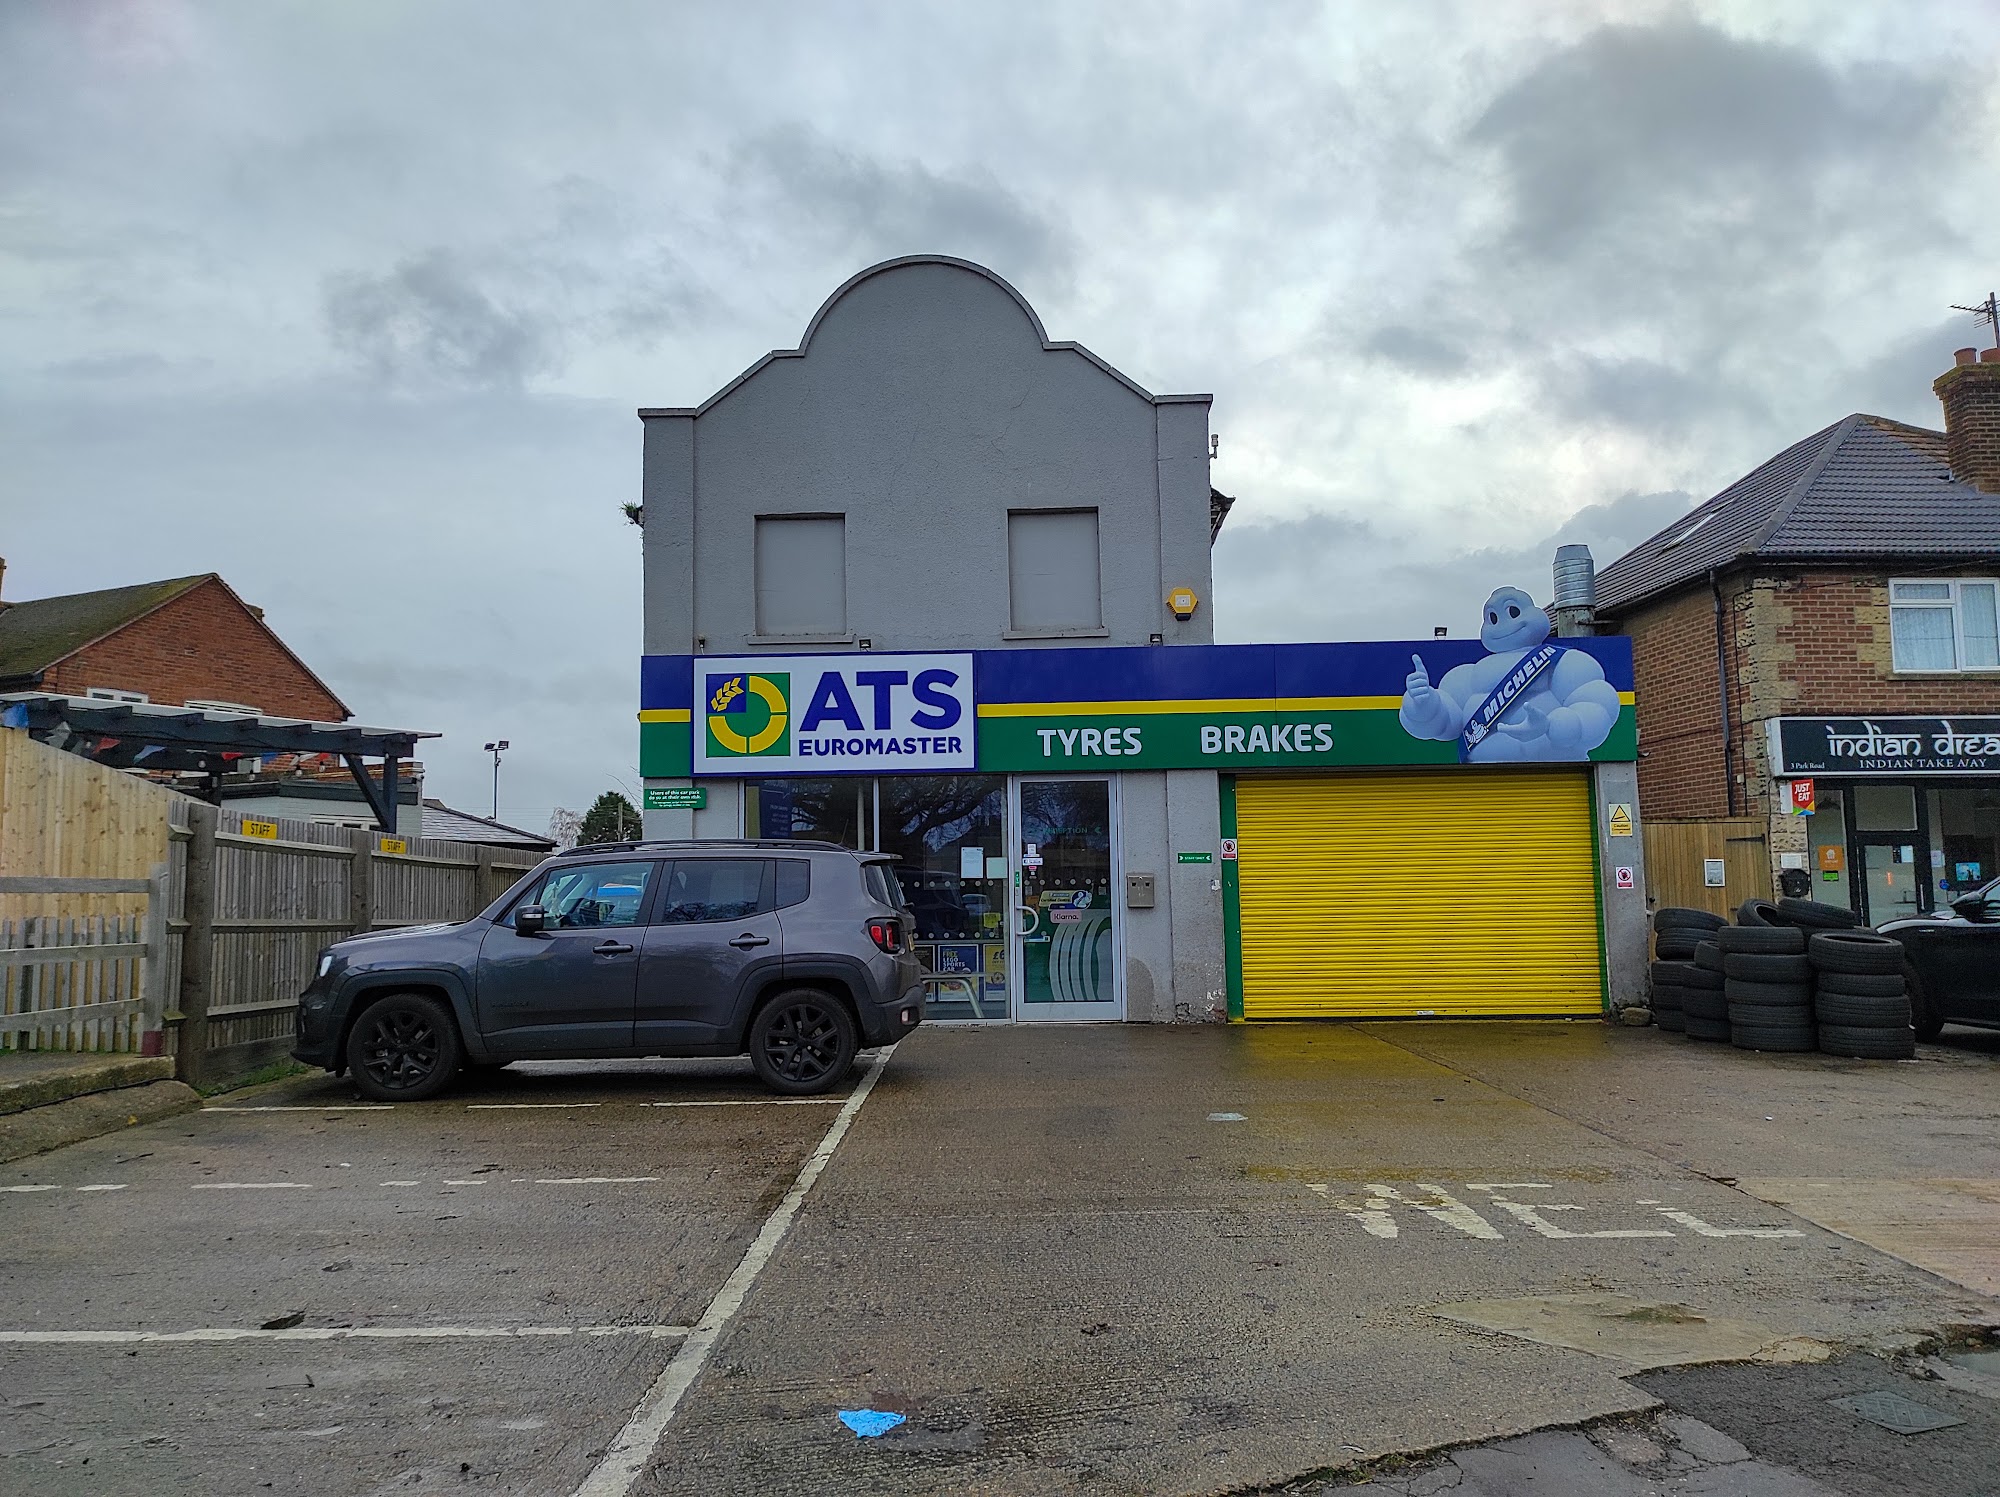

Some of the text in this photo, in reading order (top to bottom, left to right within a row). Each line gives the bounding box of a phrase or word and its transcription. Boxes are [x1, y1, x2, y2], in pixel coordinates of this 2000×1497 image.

[1483, 646, 1556, 722] MICHELIN
[799, 668, 962, 732] ATS
[798, 736, 962, 757] EUROMASTER
[1037, 727, 1142, 756] TYRES
[1200, 723, 1334, 754] BRAKES
[1859, 759, 1914, 769] INDIAN
[1916, 758, 1954, 768] TAKE
[1795, 782, 1810, 794] JUST
[1798, 791, 1810, 802] EAT
[250, 823, 271, 836] STAFF
[387, 841, 401, 851] STAFF
